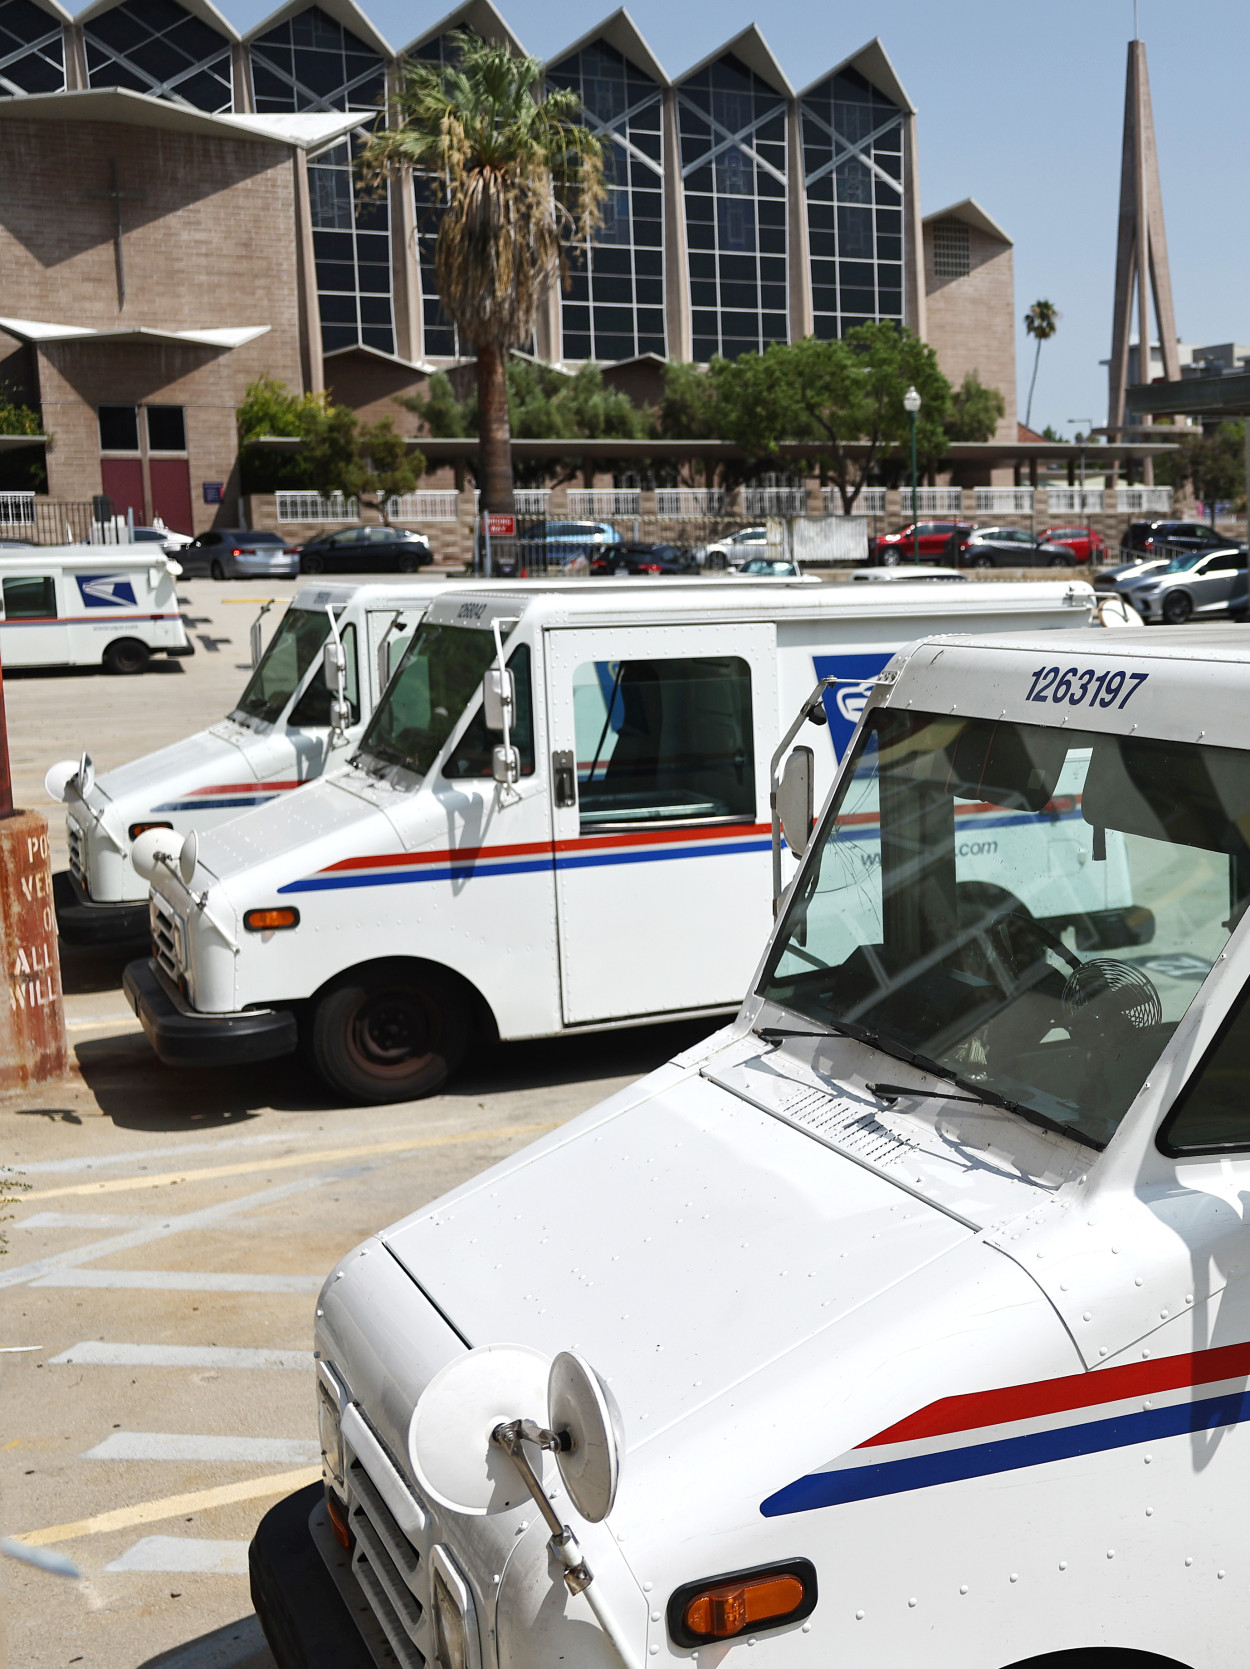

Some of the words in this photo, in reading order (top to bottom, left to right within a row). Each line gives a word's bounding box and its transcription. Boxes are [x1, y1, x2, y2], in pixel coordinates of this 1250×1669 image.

[1025, 666, 1149, 710] 1263197
[14, 943, 53, 975] ALL
[9, 976, 57, 1011] WILL
